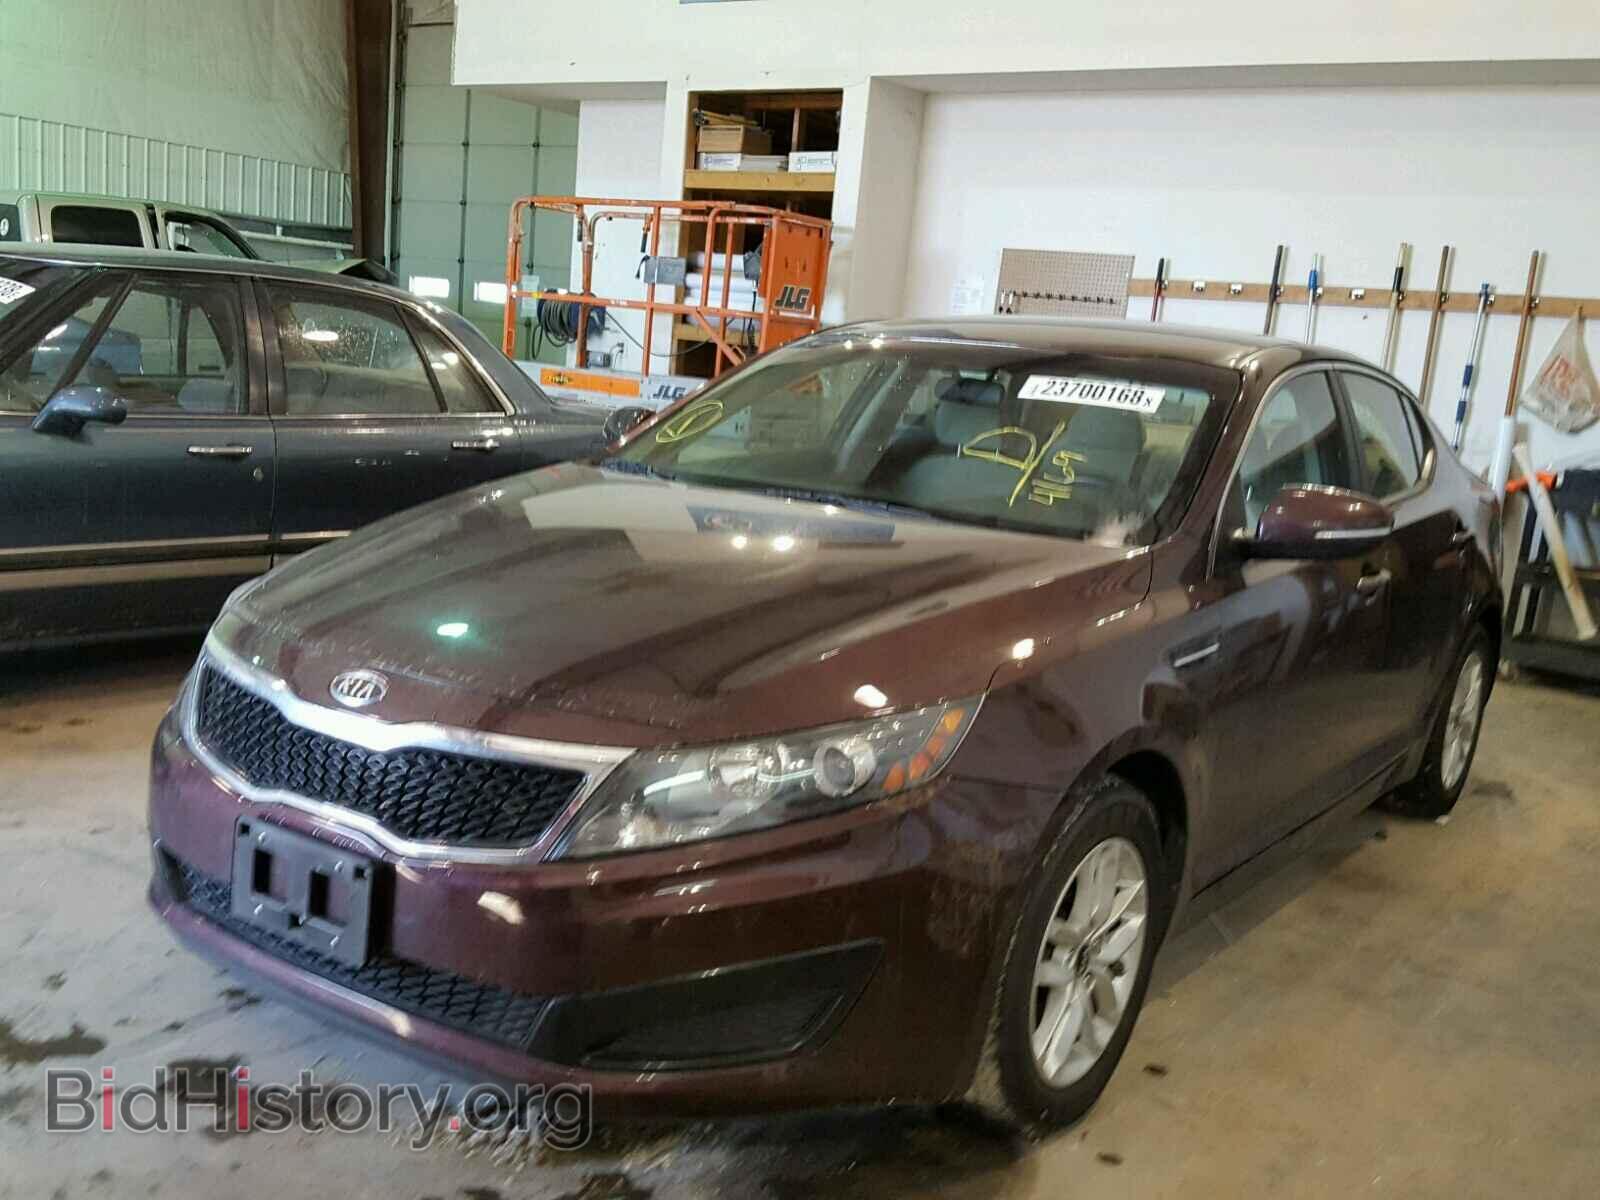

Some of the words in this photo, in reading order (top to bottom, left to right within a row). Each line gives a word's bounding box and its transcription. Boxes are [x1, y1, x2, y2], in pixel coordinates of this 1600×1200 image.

[774, 285, 811, 310] JLG
[652, 385, 687, 400] JLG
[335, 676, 376, 698] KIA
